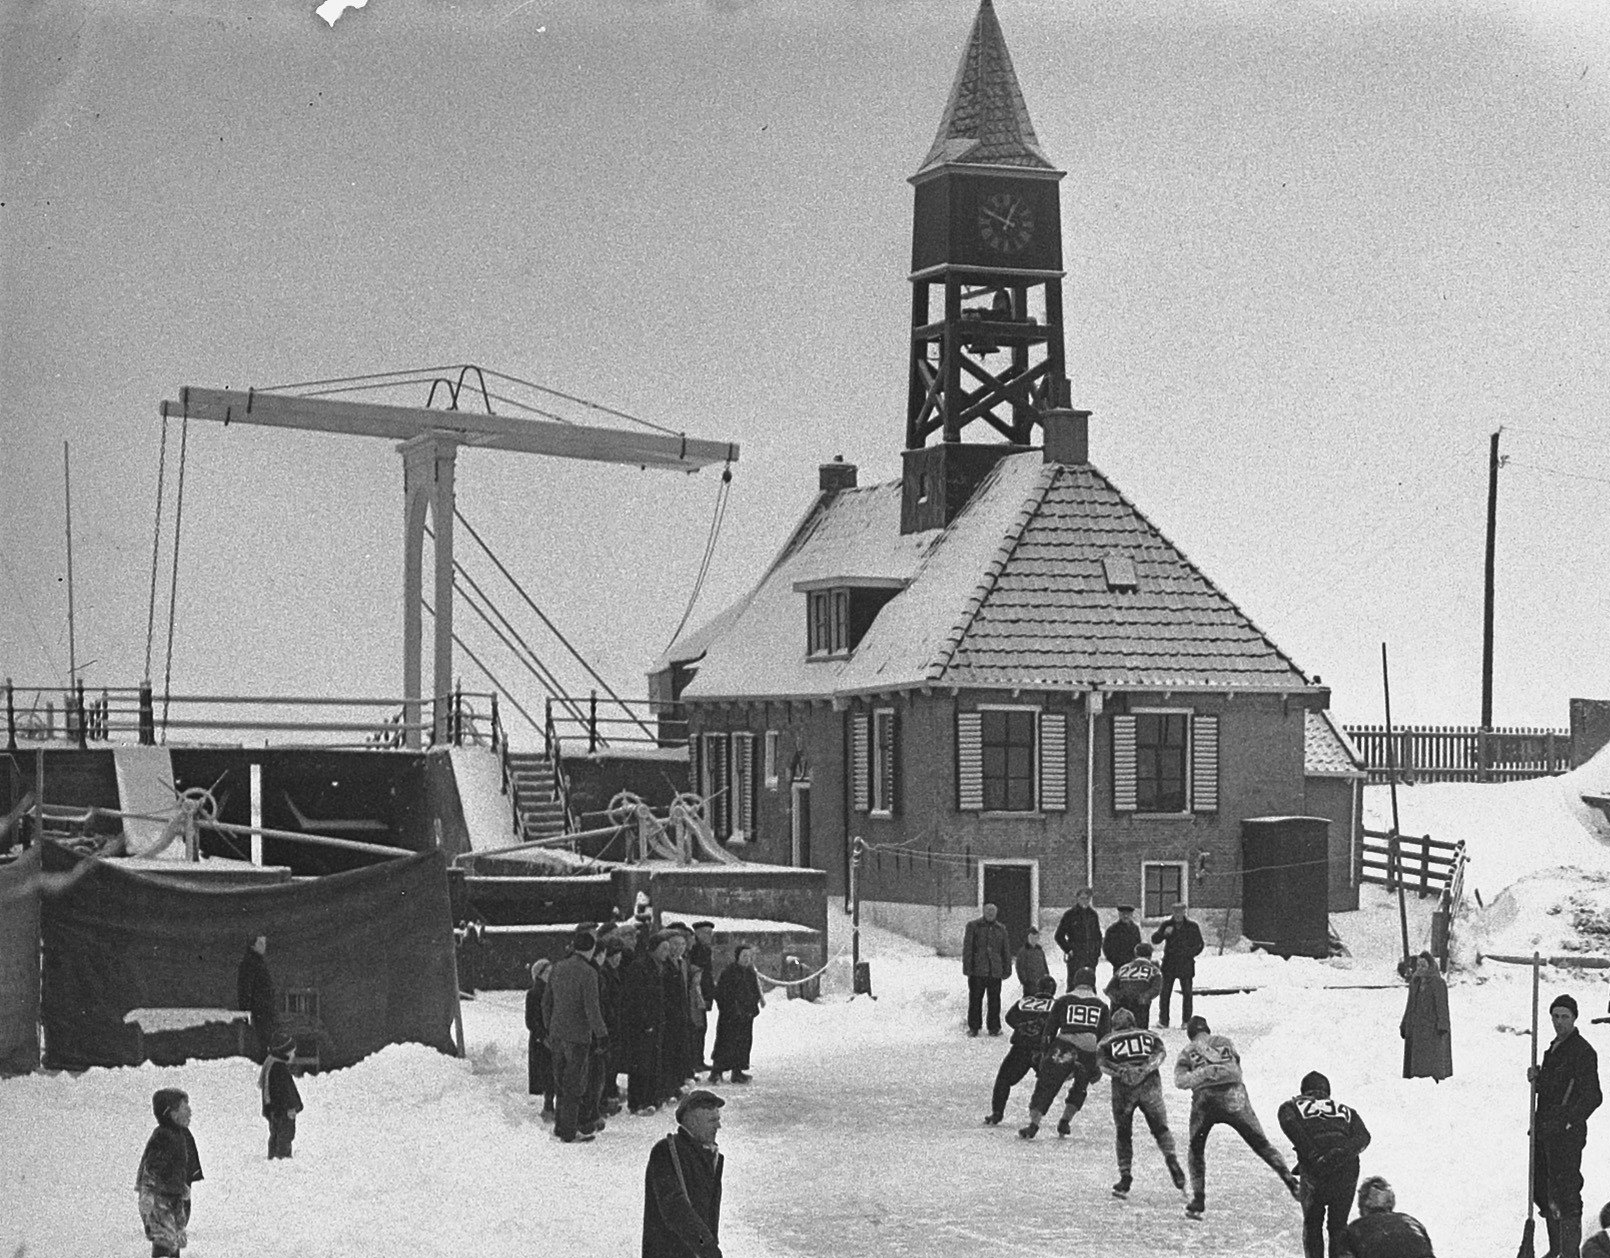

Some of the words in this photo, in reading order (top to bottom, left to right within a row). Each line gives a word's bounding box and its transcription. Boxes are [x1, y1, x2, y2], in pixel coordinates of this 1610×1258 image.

[1119, 964, 1153, 981] 229
[1021, 996, 1053, 1011] 221
[1068, 1005, 1101, 1025] 196
[1113, 1035, 1153, 1059] 209
